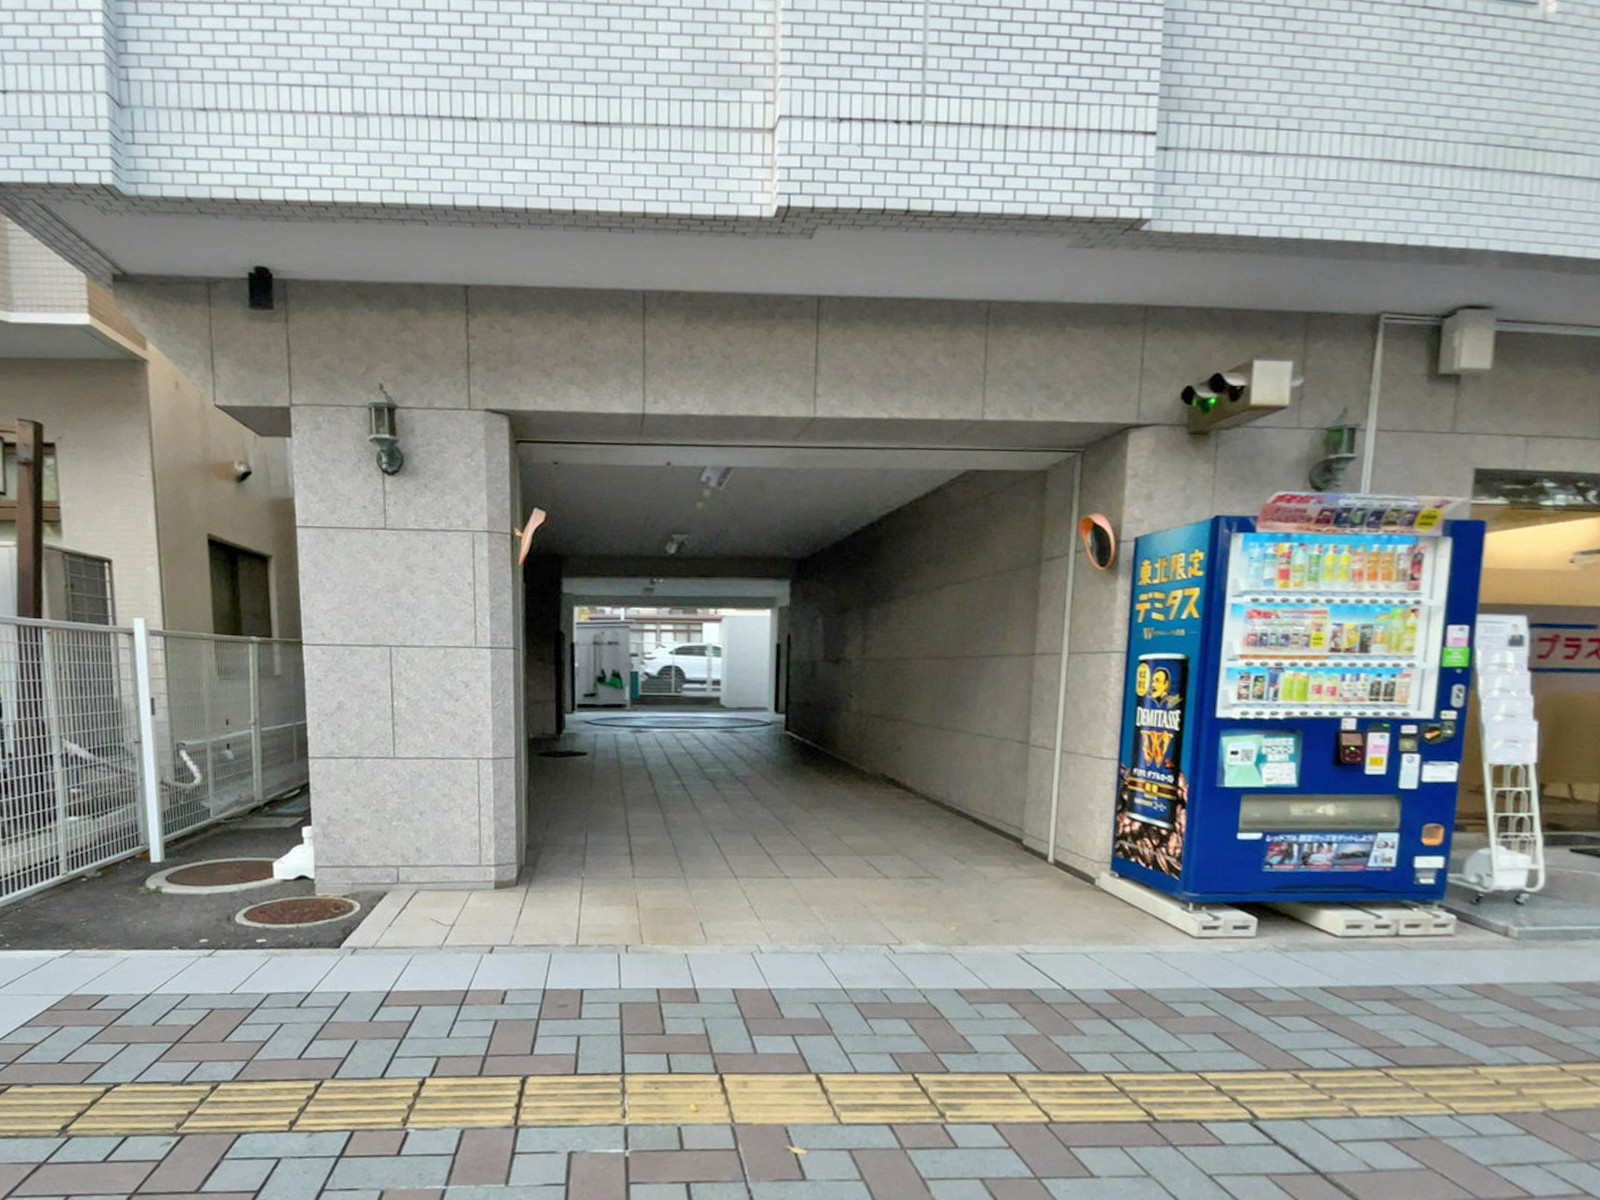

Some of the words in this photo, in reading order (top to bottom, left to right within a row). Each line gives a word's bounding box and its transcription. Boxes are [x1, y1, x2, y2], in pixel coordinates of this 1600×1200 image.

[1137, 549, 1204, 585] 東北限定
[1135, 587, 1200, 623] デミタス
[1136, 706, 1181, 731] DEMITASSE
